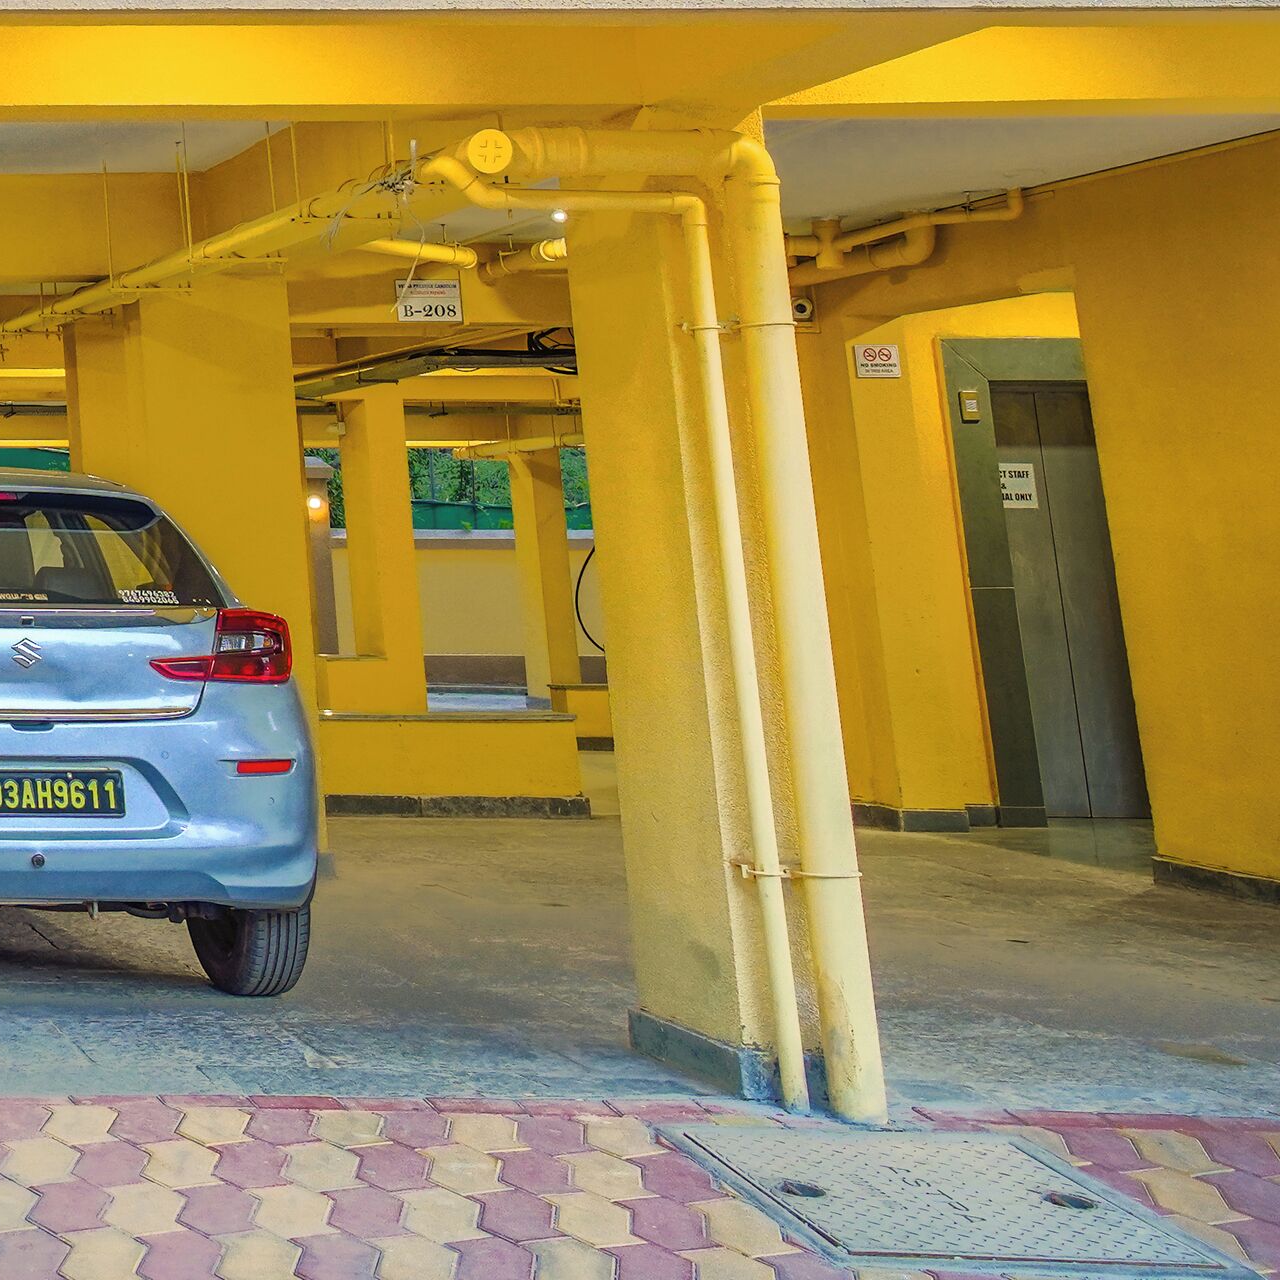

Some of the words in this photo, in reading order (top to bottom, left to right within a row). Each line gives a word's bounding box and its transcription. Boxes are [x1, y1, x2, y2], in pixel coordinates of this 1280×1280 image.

[403, 304, 457, 318] B-208
[1008, 470, 1029, 478] STAFF
[1000, 482, 1007, 490] &
[1015, 493, 1032, 501] ONLY
